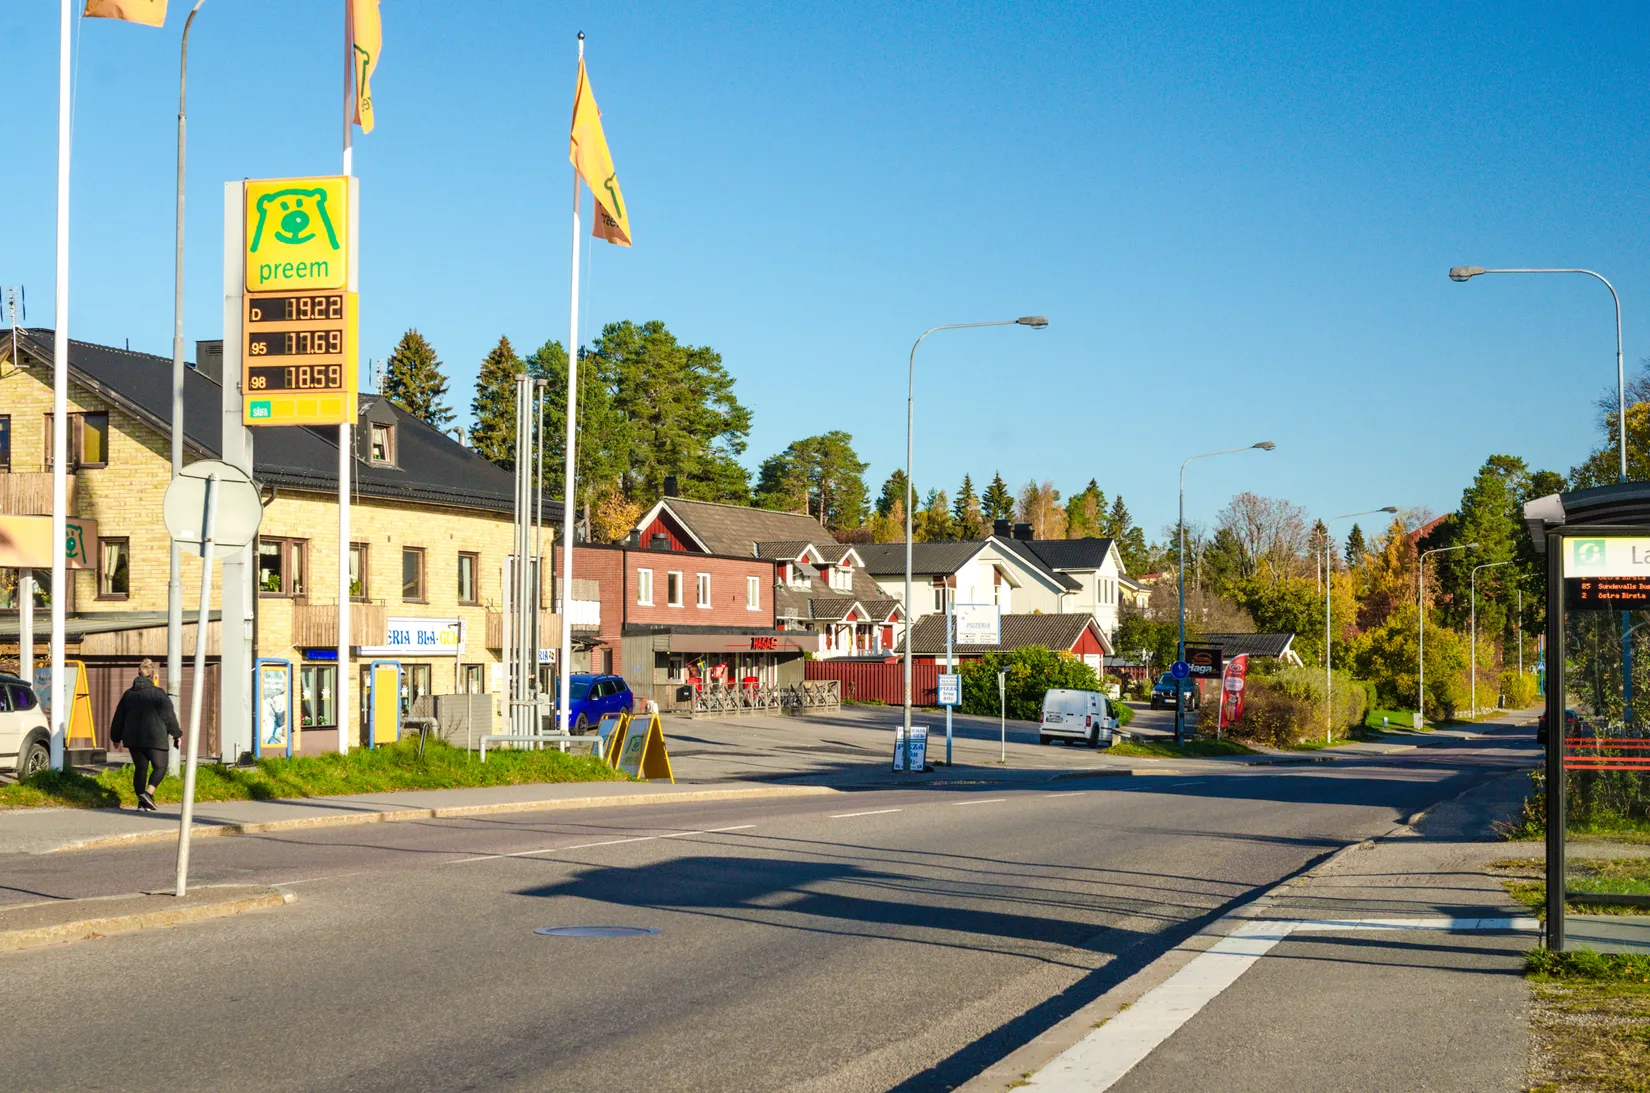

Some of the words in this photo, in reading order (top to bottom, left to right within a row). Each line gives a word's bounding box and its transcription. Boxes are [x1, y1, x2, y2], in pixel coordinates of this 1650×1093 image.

[260, 261, 328, 284] preem
[251, 309, 261, 320] D
[291, 297, 341, 319] 19.22
[251, 342, 267, 354] 95
[290, 331, 341, 354] 17.69
[251, 377, 266, 388] 98
[290, 366, 341, 388] 18.59
[1188, 663, 1212, 674] Haga
